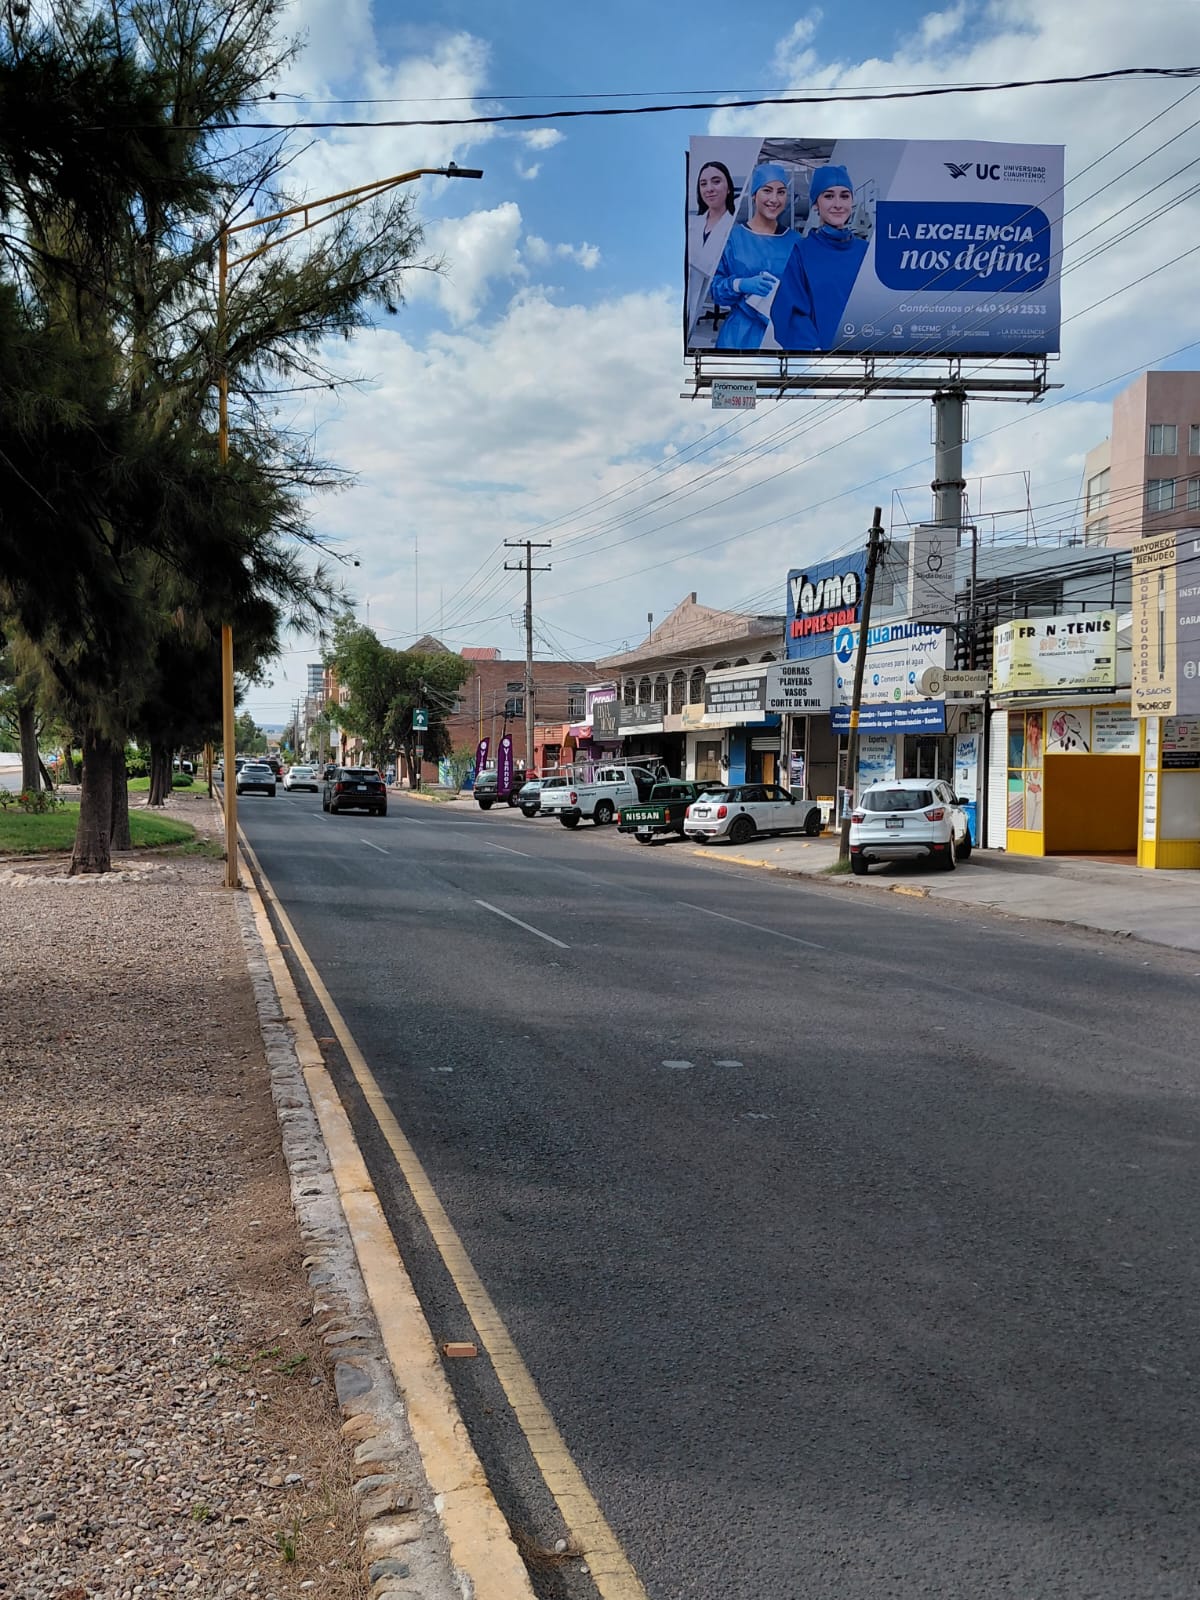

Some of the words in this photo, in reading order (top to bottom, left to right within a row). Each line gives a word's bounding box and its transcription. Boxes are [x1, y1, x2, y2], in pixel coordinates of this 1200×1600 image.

[976, 163, 1000, 180] UC
[1003, 165, 1046, 173] UNIVERSIDAD
[888, 223, 911, 239] LA
[915, 223, 1034, 243] EXCELENCIA
[900, 250, 951, 270] nos
[954, 243, 1044, 278] define.
[1020, 305, 1046, 314] 2533
[1136, 550, 1175, 565] MENUDEO
[790, 571, 860, 618] Yasma
[790, 607, 856, 639] IMPRESION
[911, 639, 938, 653] norte
[1146, 687, 1172, 696] SACHS
[626, 812, 660, 821] NISSAN
